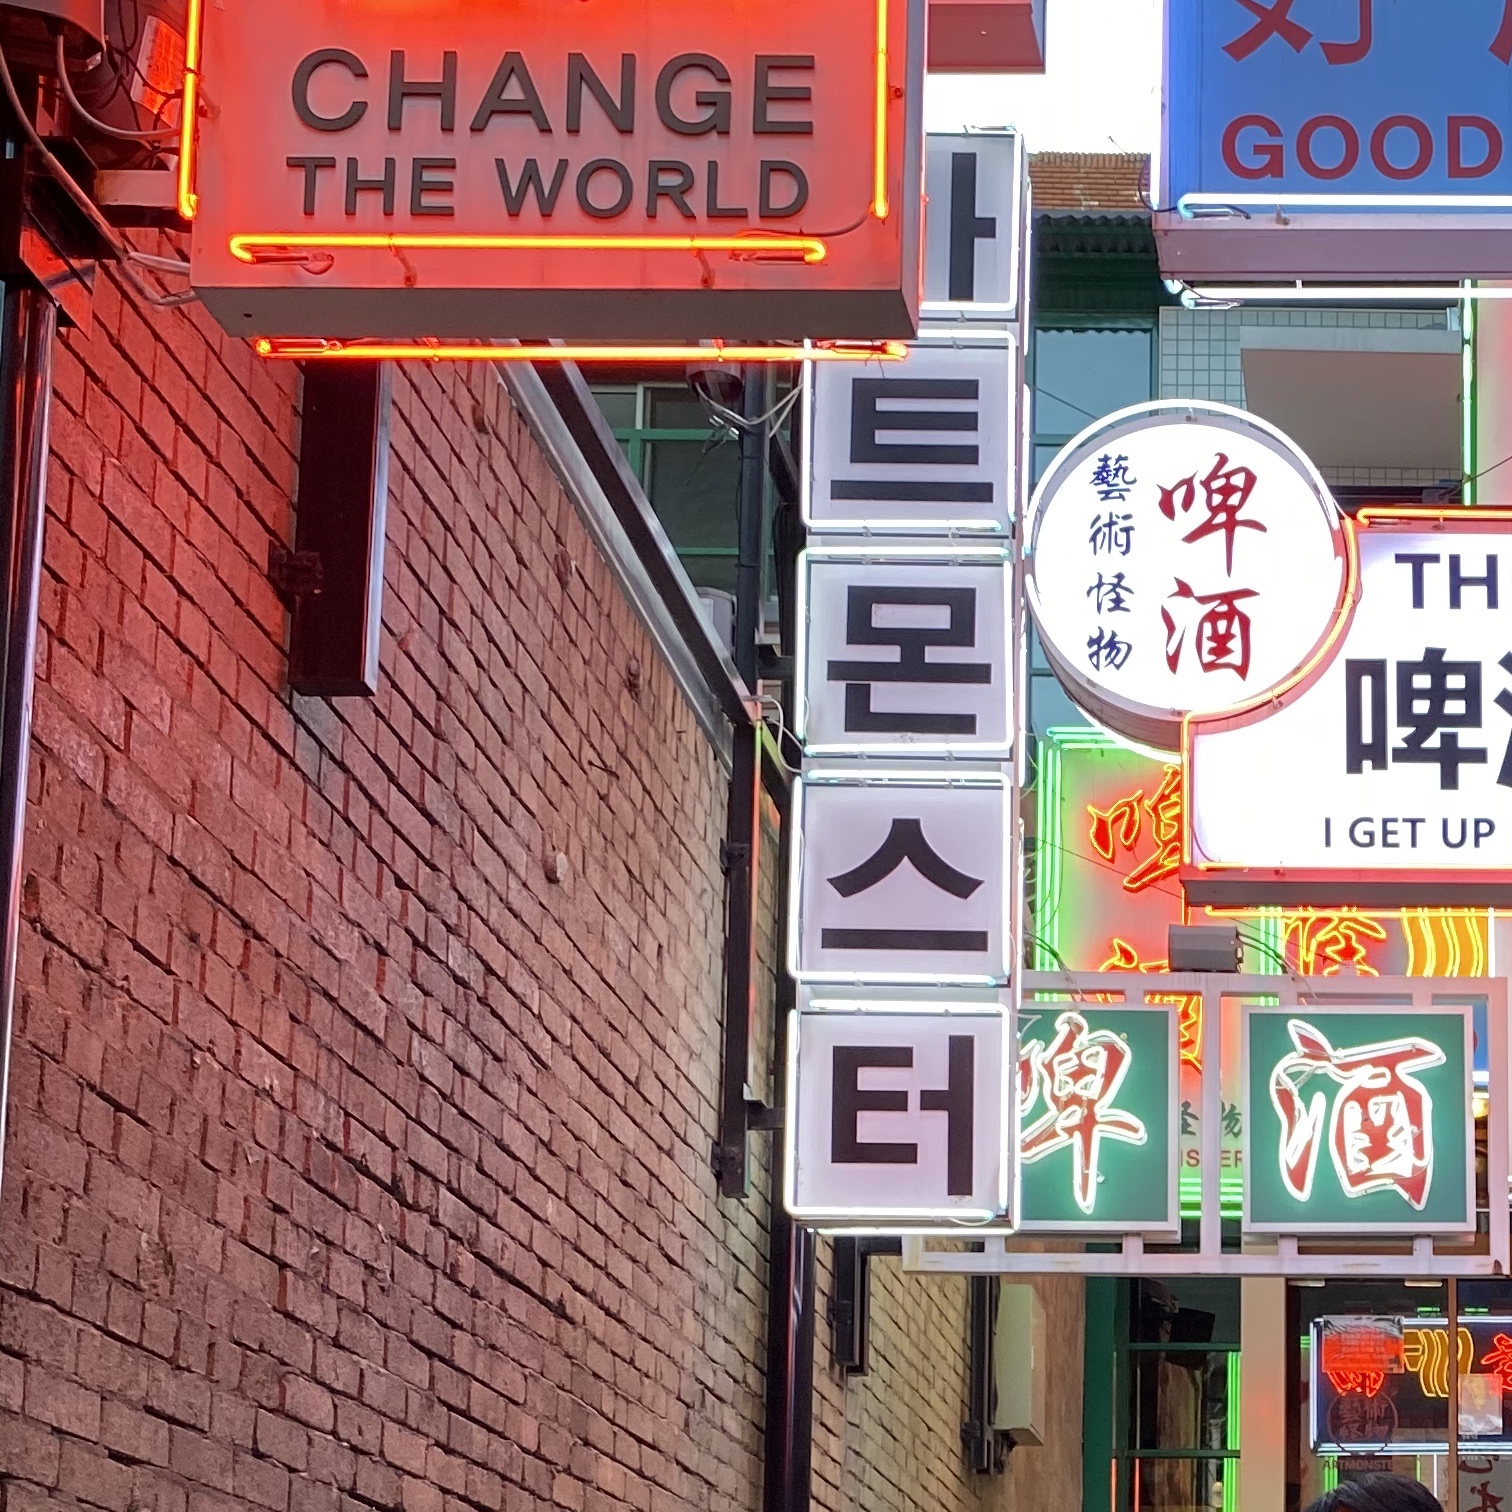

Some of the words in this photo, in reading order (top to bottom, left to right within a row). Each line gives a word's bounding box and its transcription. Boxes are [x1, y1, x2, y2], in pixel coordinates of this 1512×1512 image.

[291, 47, 816, 137] CHANGE
[1221, 114, 1504, 181] GOOD
[286, 157, 457, 217] THE
[494, 158, 810, 219] WORLD
[1086, 453, 1137, 672] 藝術怪物
[1156, 452, 1268, 682] 啤酒
[1324, 817, 1332, 848] I
[1348, 816, 1427, 849] GET
[1441, 817, 1496, 849] UP
